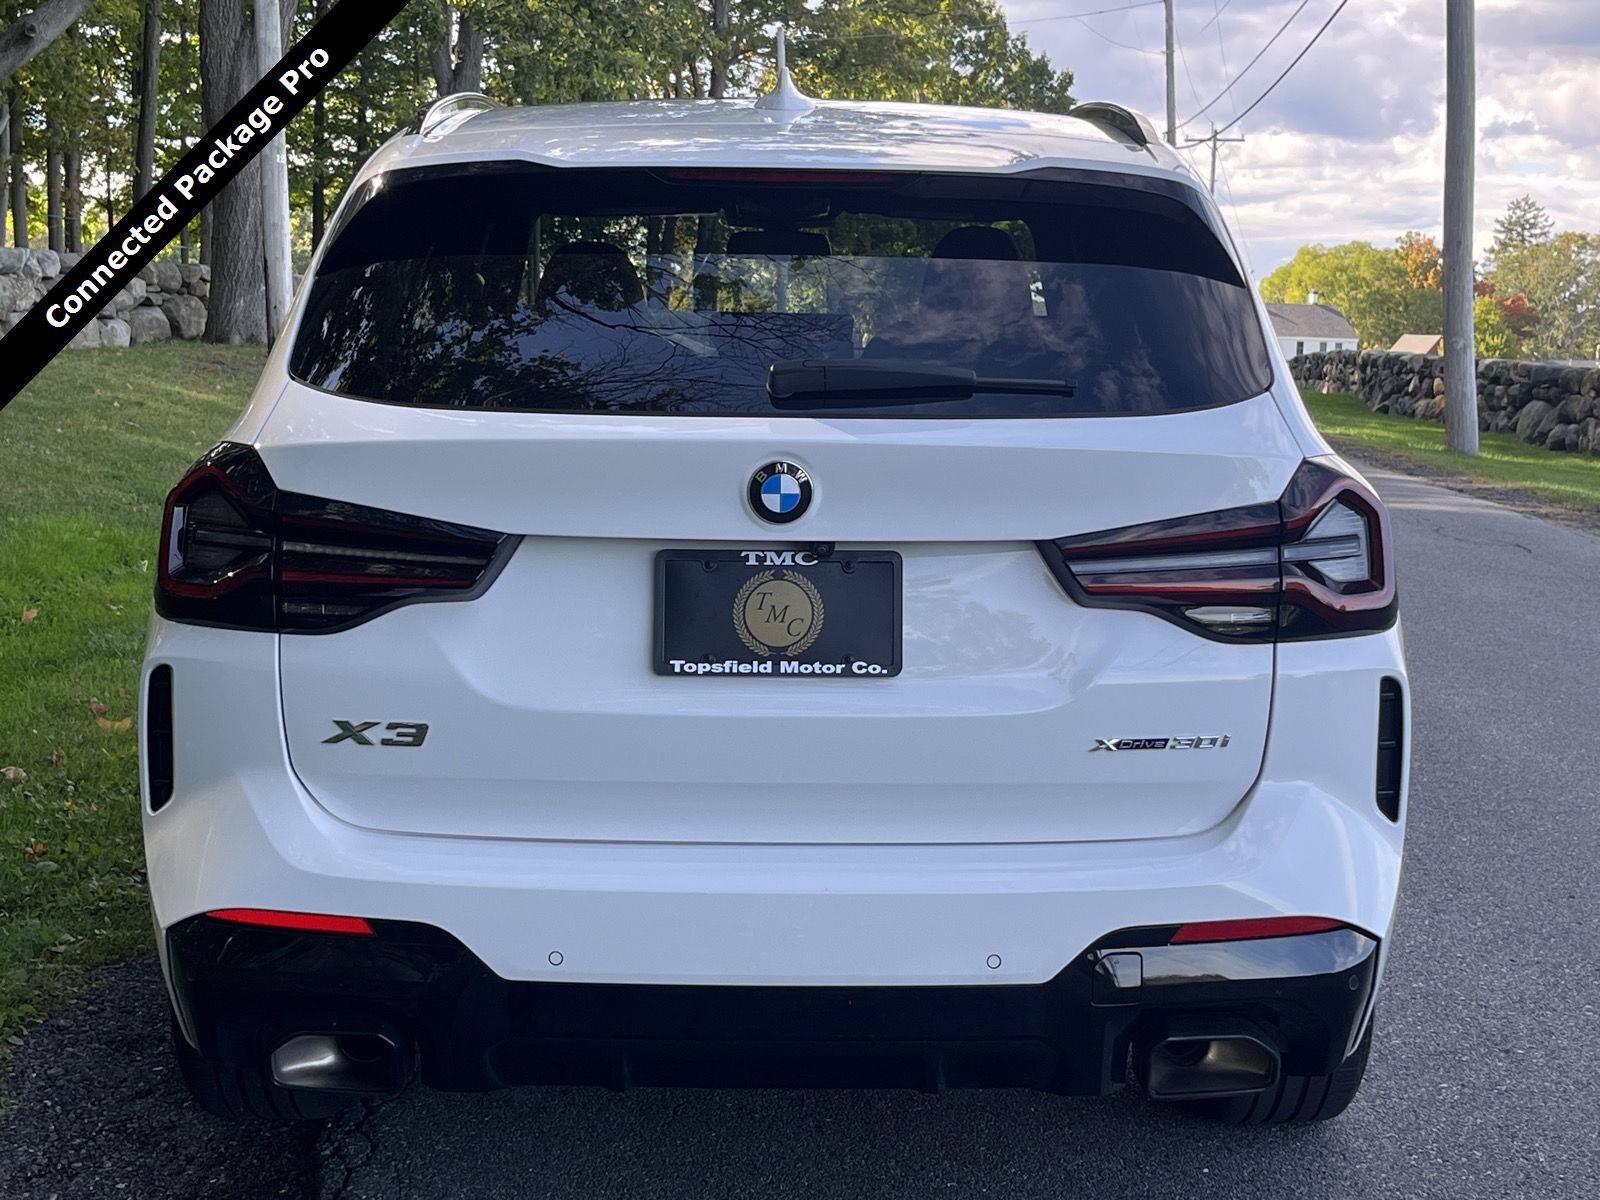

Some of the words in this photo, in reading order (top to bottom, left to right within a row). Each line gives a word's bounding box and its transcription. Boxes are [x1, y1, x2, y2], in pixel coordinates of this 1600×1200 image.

[755, 463, 808, 484] BMW
[740, 551, 819, 566] TMC
[669, 660, 773, 675] Topsfield
[780, 661, 845, 674] Motor
[851, 661, 888, 674] Co.
[320, 719, 429, 747] X3
